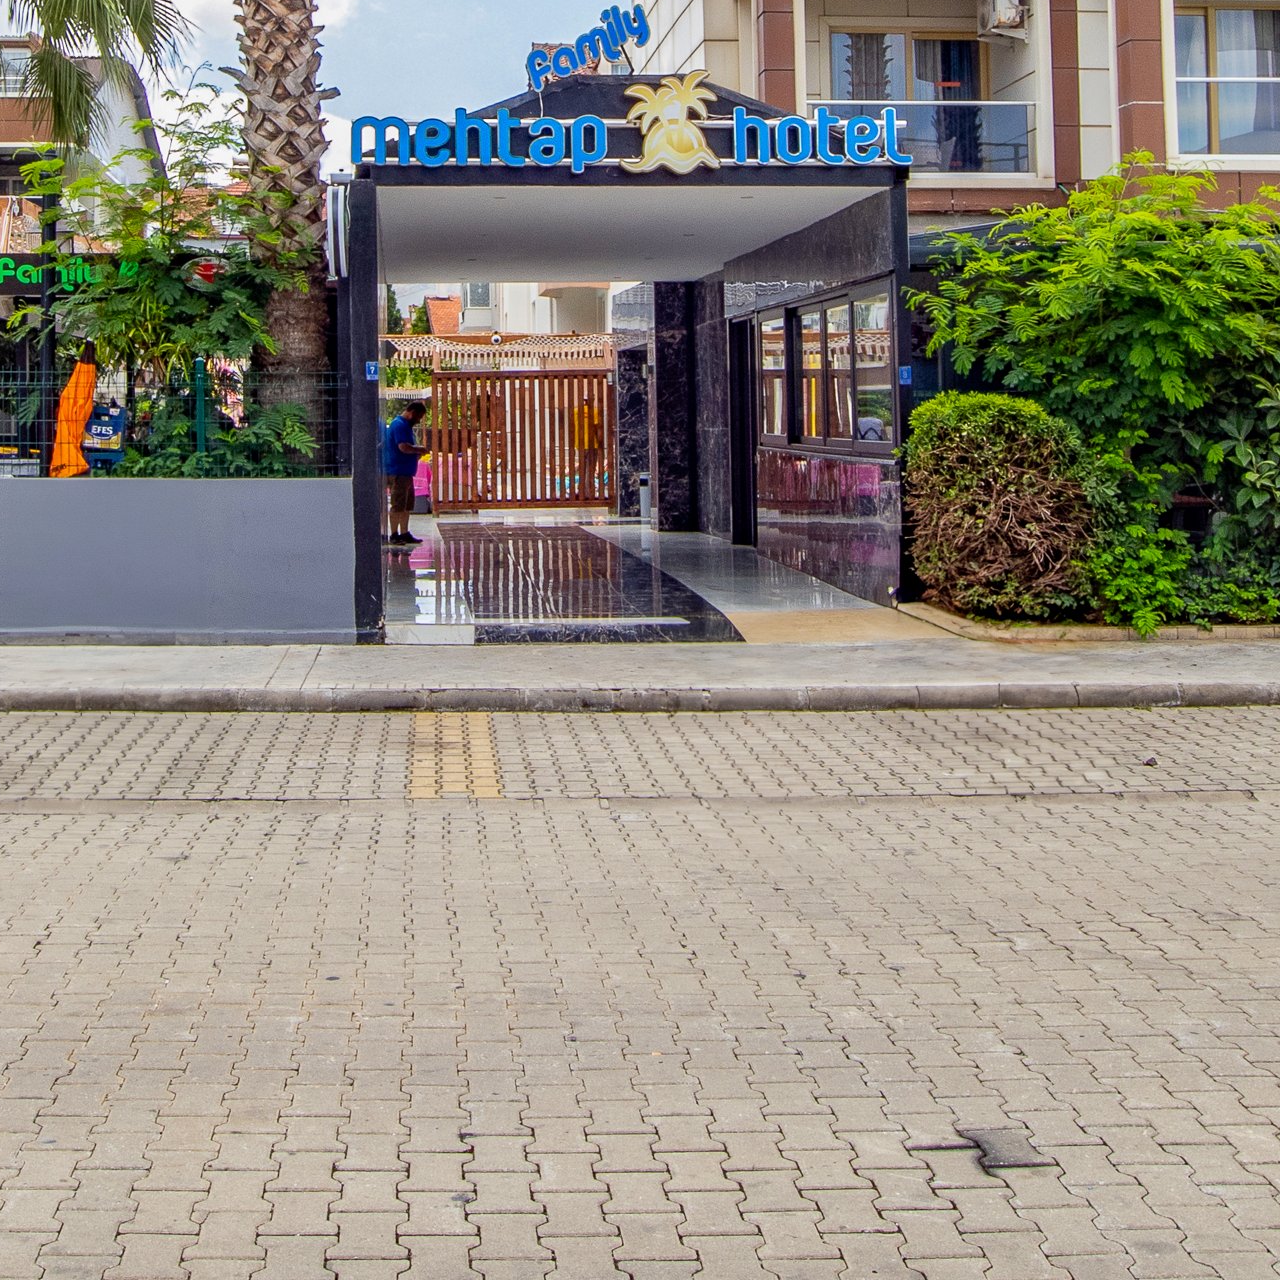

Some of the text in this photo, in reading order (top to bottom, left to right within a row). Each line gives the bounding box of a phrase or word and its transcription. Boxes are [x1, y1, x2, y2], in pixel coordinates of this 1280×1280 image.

[351, 106, 913, 174] mehtap hotel
[91, 425, 113, 435] EFES
